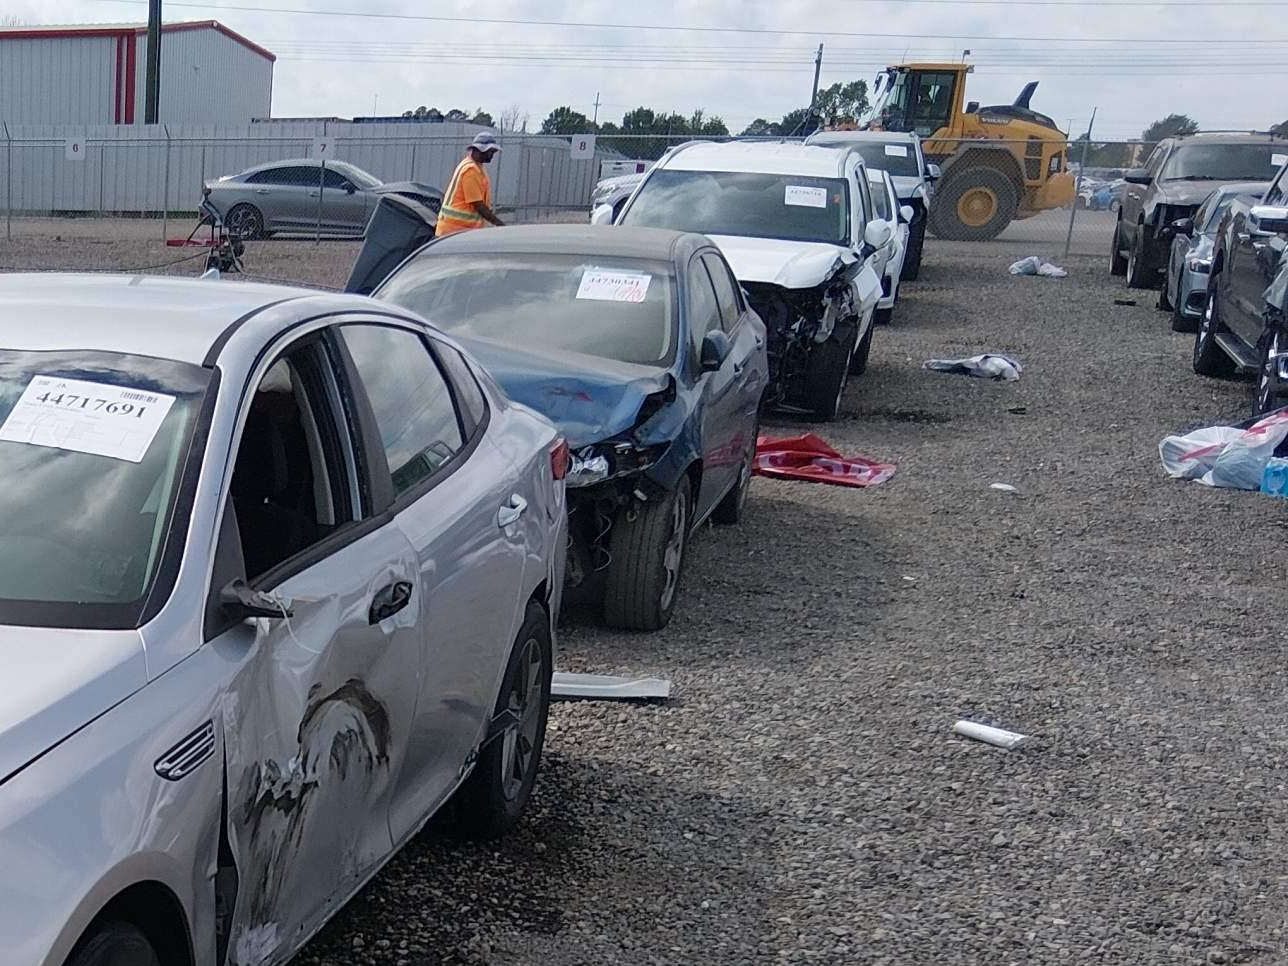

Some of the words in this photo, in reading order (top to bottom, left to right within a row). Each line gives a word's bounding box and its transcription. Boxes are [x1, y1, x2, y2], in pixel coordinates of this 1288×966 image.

[320, 143, 327, 153] 7
[579, 141, 587, 151] 8
[36, 391, 147, 418] 44717691
